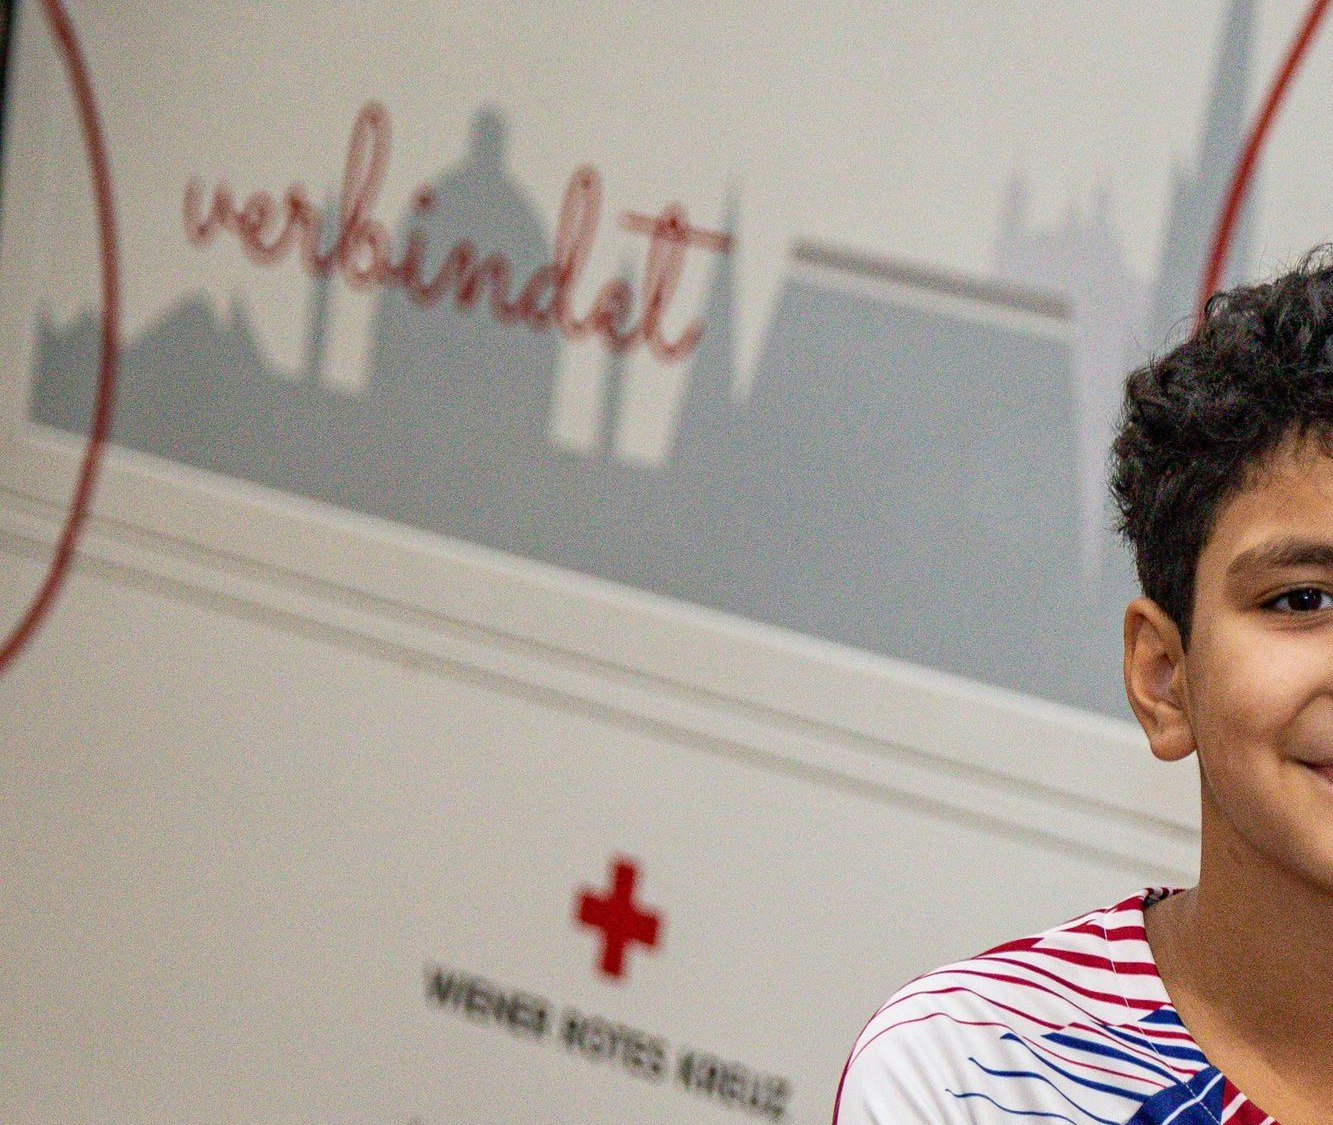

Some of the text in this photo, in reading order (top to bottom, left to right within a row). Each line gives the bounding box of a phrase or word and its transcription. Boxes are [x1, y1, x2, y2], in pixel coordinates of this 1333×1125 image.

[184, 100, 733, 362] verbindet
[427, 963, 791, 1122] WIENER ROTES KREUZ
